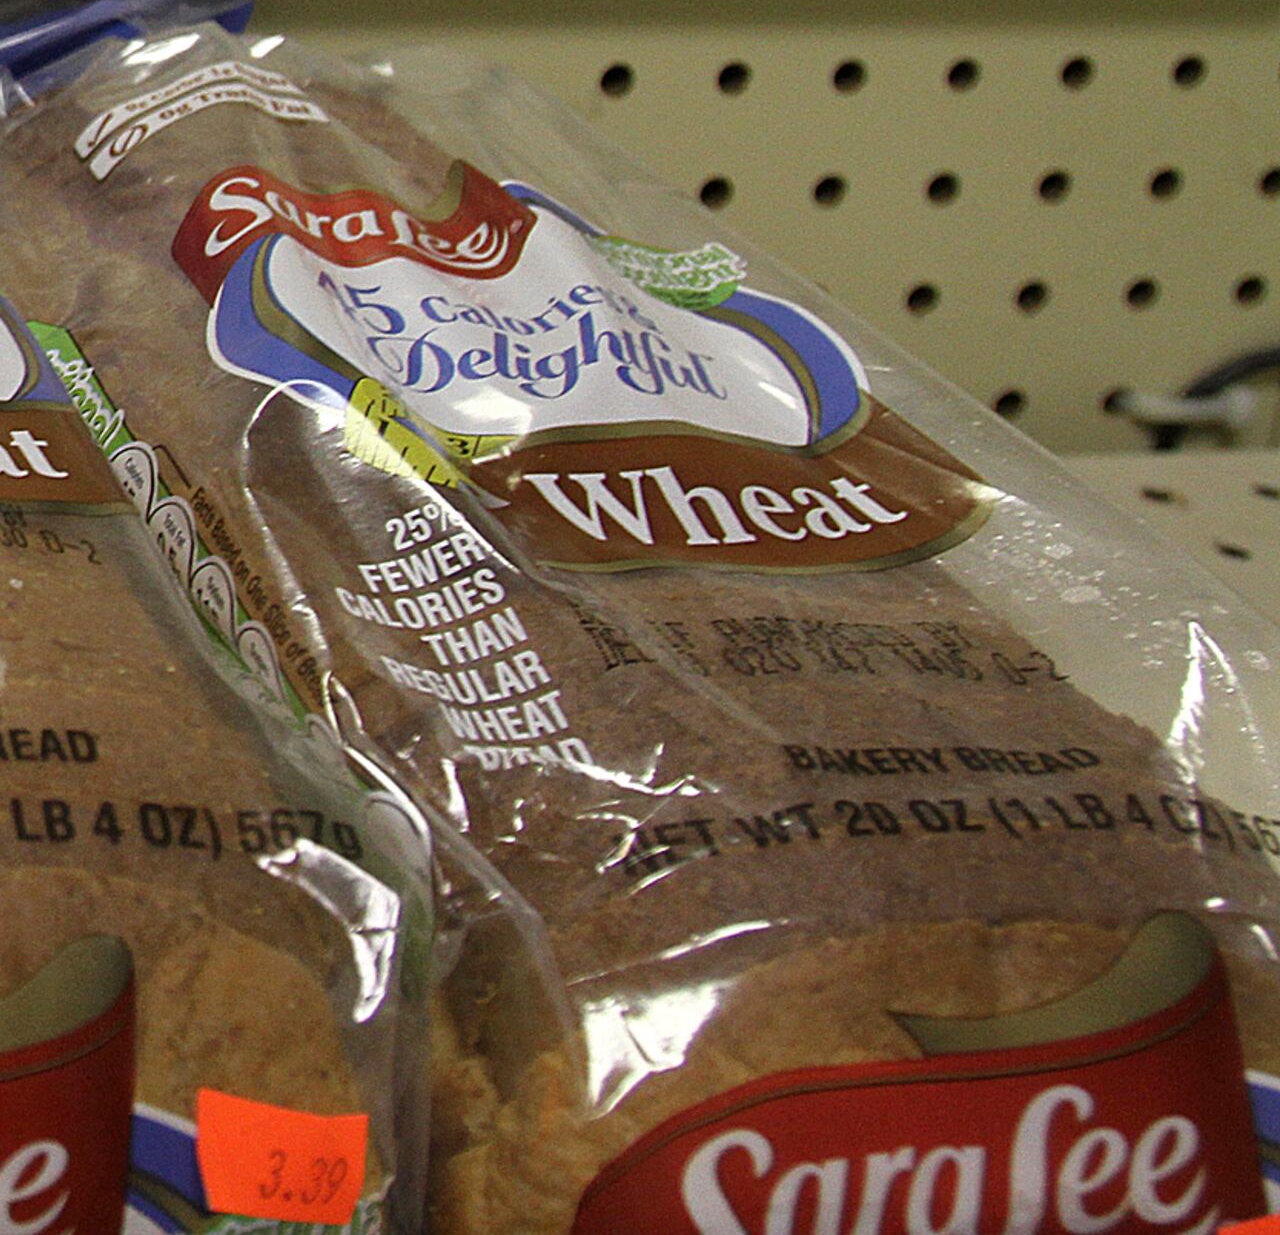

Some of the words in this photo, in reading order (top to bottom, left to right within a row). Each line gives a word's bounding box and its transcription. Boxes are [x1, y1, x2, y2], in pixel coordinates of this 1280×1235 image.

[203, 175, 385, 257] Sara
[384, 503, 465, 552] 25%
[521, 465, 908, 547] Wheat
[357, 531, 487, 594] FEWER
[335, 567, 506, 630] CALORIES
[419, 606, 529, 666] THAN
[379, 650, 552, 706] REGULAR
[440, 690, 569, 743] WHEAT
[781, 743, 942, 776] BAKERY
[953, 745, 1100, 776] BREAD
[12, 798, 77, 845] LB
[92, 800, 122, 843] 4
[140, 802, 223, 858] OZ)
[737, 801, 821, 848] WT
[837, 797, 900, 840] 20
[907, 798, 985, 837] OZ
[990, 797, 1041, 841] (1
[1047, 792, 1116, 832] LB
[1124, 792, 1153, 830] 4
[1236, 805, 1280, 856] 567
[680, 1128, 987, 1235] Sara
[1002, 1083, 1224, 1235] Lee
